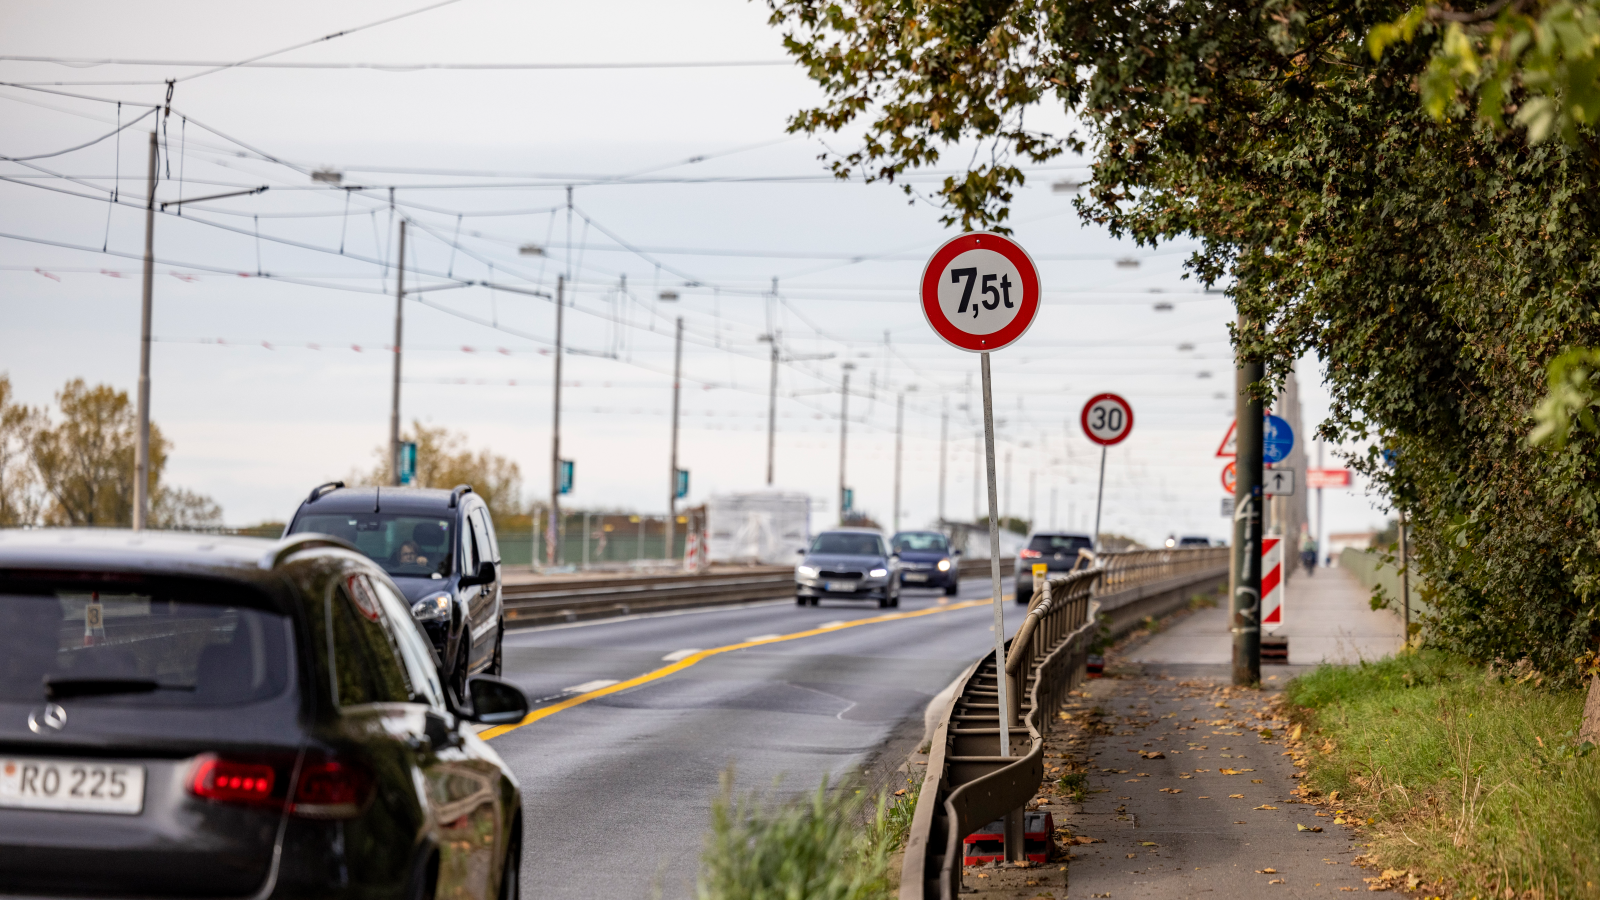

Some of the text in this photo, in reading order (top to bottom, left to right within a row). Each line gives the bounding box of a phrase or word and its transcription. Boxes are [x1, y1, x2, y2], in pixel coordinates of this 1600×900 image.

[951, 267, 1014, 319] 7,5t
[1091, 405, 1123, 432] 30
[20, 764, 127, 799] RO 225
